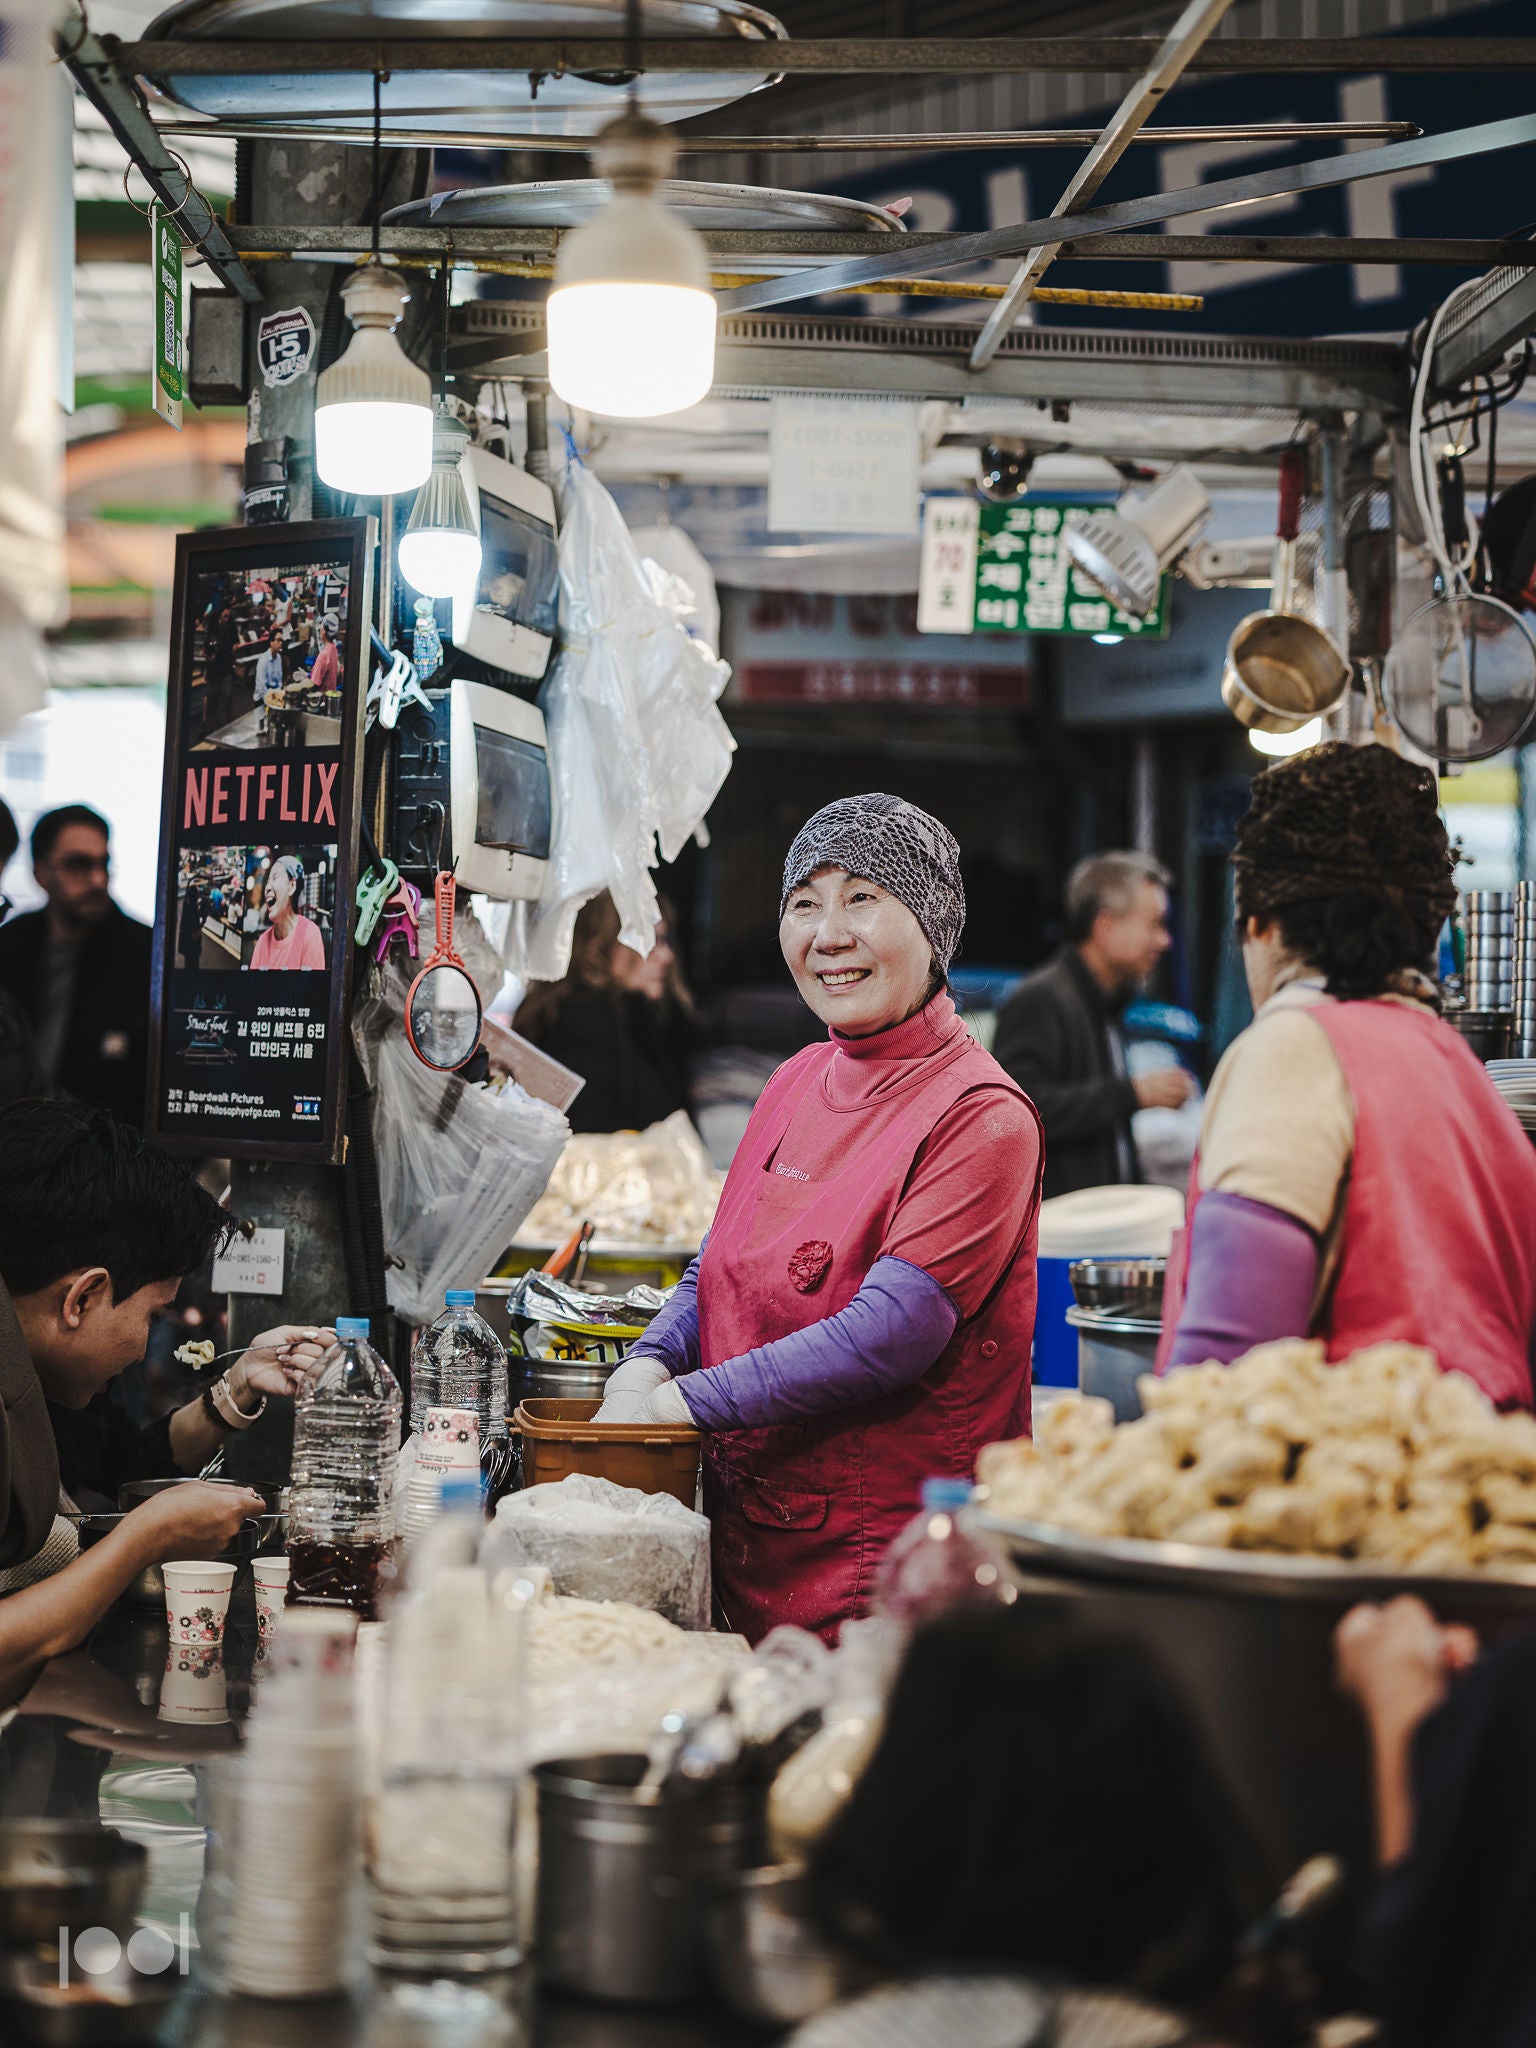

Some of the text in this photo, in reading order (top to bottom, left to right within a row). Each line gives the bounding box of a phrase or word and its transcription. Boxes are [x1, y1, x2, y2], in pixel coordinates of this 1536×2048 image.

[268, 332, 302, 362] I-5
[184, 763, 339, 829] NETFLIX
[257, 1006, 272, 1016] 2019
[237, 1021, 247, 1037] 길
[250, 1021, 270, 1038] 위의
[307, 1023, 325, 1039] 6편
[250, 1041, 313, 1059] 대한민국 서울
[188, 1090, 229, 1103] Boardwalk
[230, 1092, 264, 1105] Pictures
[204, 1104, 281, 1120] Philosophyofgo.com
